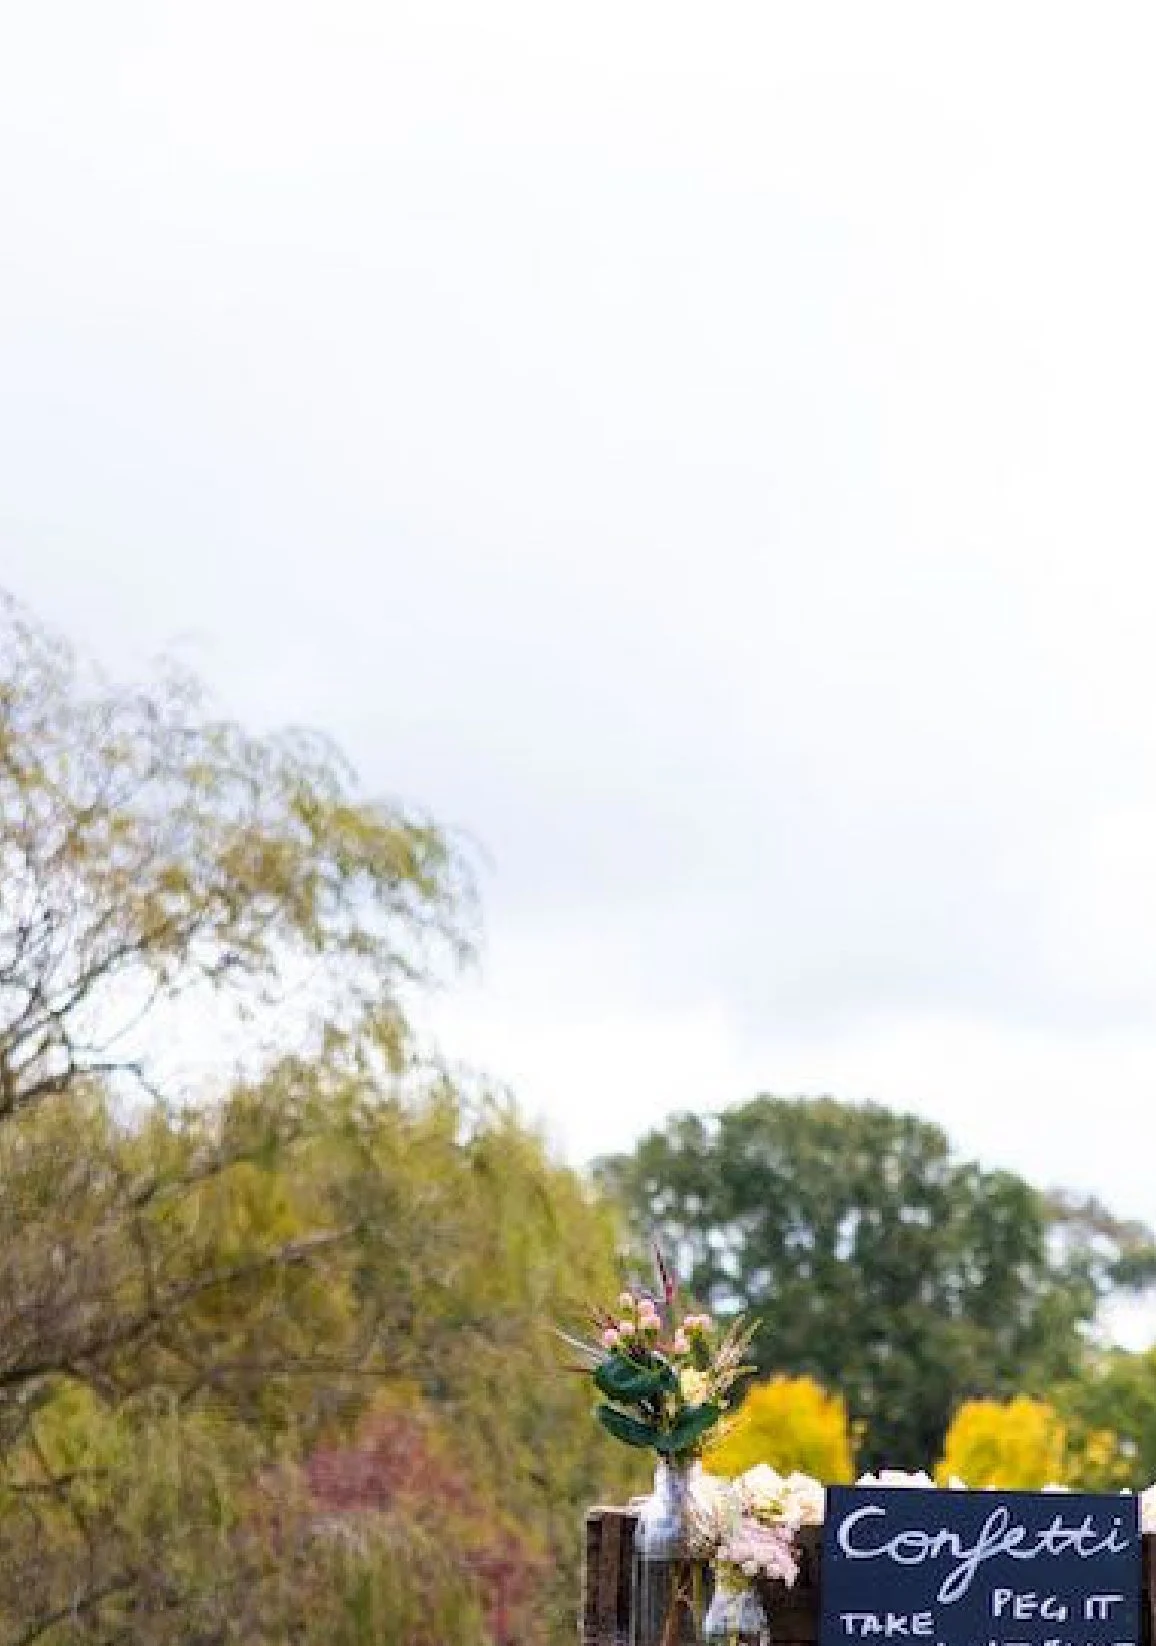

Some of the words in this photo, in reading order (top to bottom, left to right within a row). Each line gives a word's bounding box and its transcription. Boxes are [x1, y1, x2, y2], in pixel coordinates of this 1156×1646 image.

[837, 1506, 1130, 1604] Confetti
[990, 1588, 1067, 1622] PEG
[1084, 1594, 1124, 1620] IT
[839, 1611, 935, 1636] TAKE
